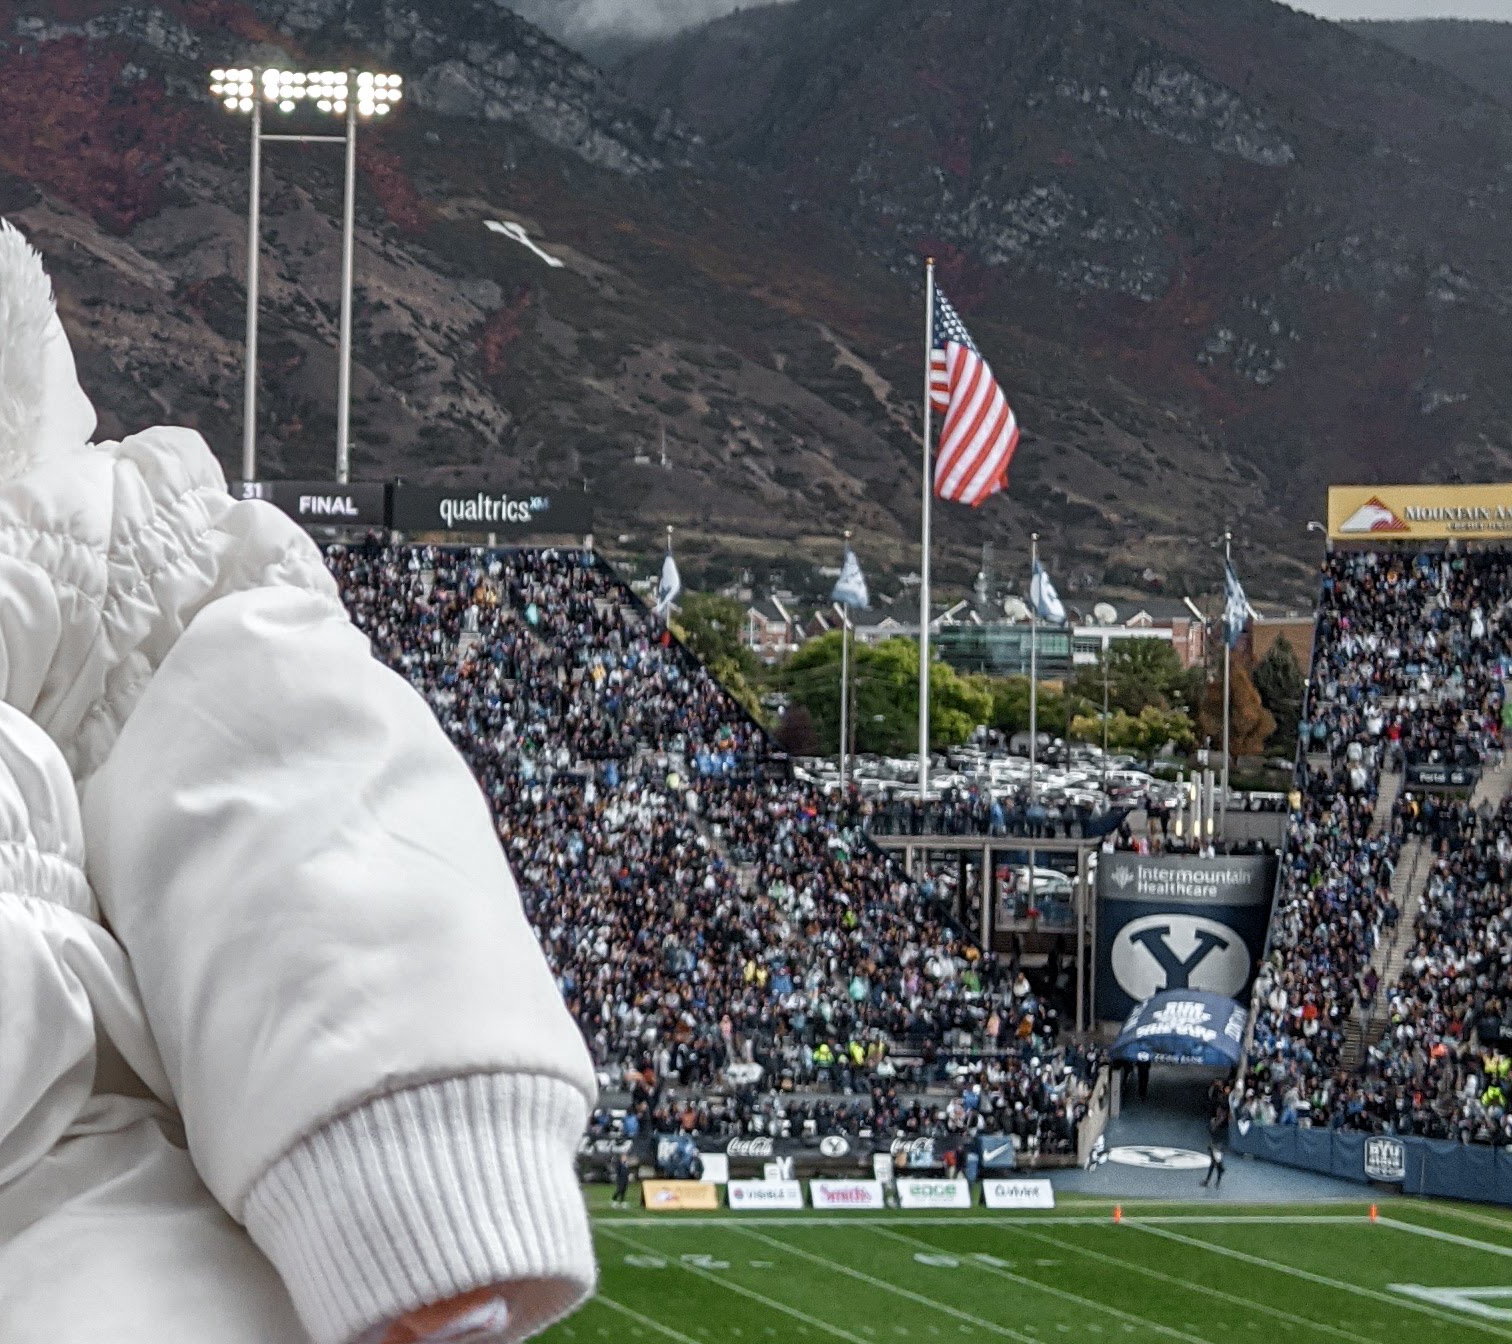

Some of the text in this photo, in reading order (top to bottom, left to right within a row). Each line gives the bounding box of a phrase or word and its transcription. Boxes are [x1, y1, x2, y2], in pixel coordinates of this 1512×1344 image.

[243, 482, 263, 499] 31
[299, 495, 359, 516] FINAL
[439, 491, 532, 528] qualtrics
[1138, 864, 1251, 885] Intermountain
[1138, 879, 1218, 897] Healthcare
